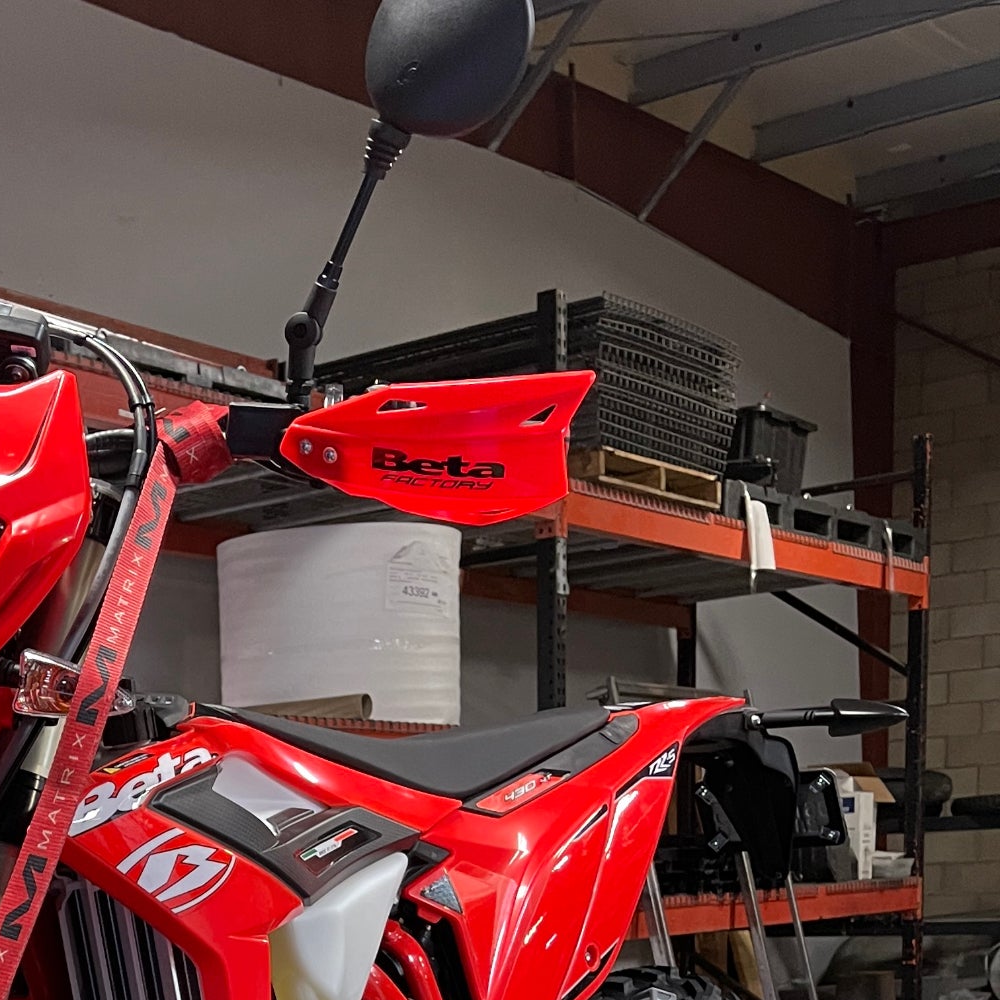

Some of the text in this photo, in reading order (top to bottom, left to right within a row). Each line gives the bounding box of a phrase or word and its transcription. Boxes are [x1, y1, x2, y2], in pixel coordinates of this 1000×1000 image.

[371, 447, 504, 479] Beta
[380, 474, 495, 490] FACTORY
[402, 586, 430, 599] 43392
[37, 732, 88, 850] MATRIX
[106, 552, 144, 645] MATRIX
[67, 747, 218, 838] Beta
[504, 780, 536, 801] 430
